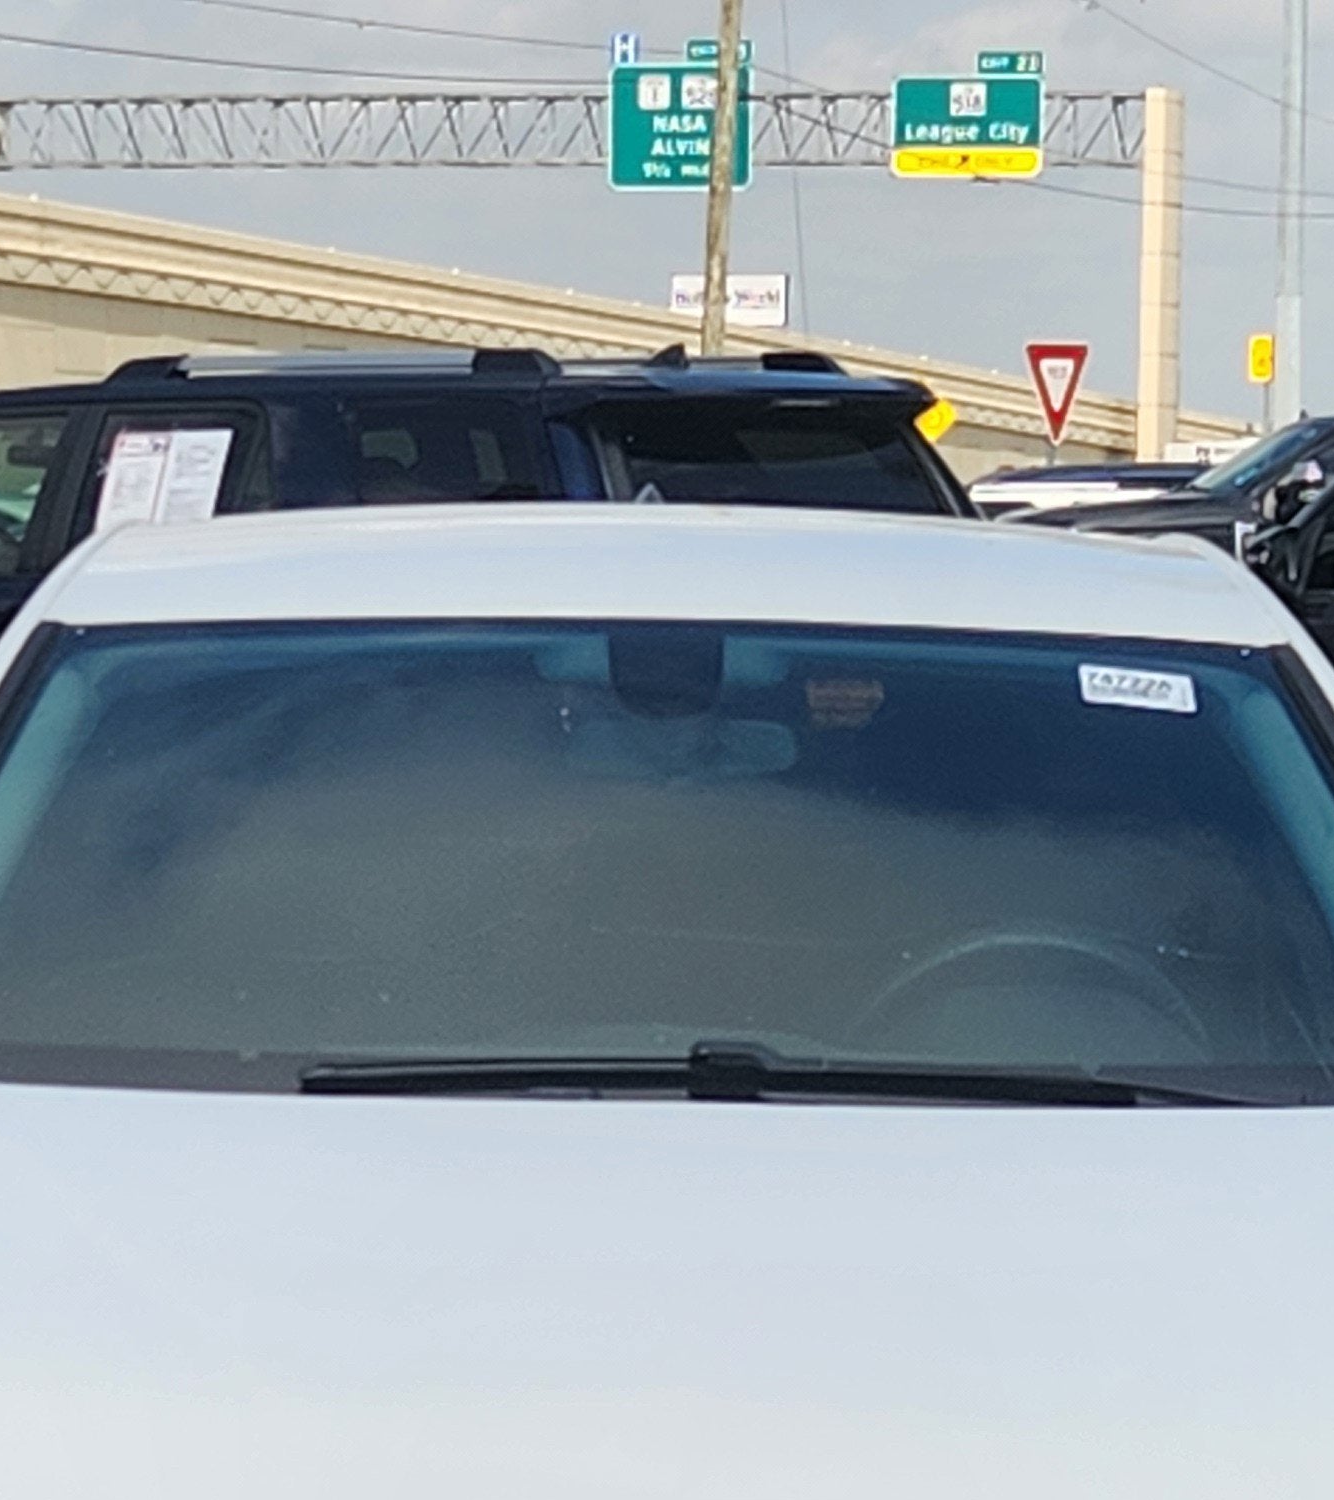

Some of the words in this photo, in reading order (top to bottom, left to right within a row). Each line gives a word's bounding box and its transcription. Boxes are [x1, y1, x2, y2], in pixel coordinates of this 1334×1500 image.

[615, 33, 635, 63] H
[652, 114, 707, 133] NASA
[904, 122, 980, 144] League
[988, 120, 1029, 144] City
[650, 137, 711, 156] ALVIN
